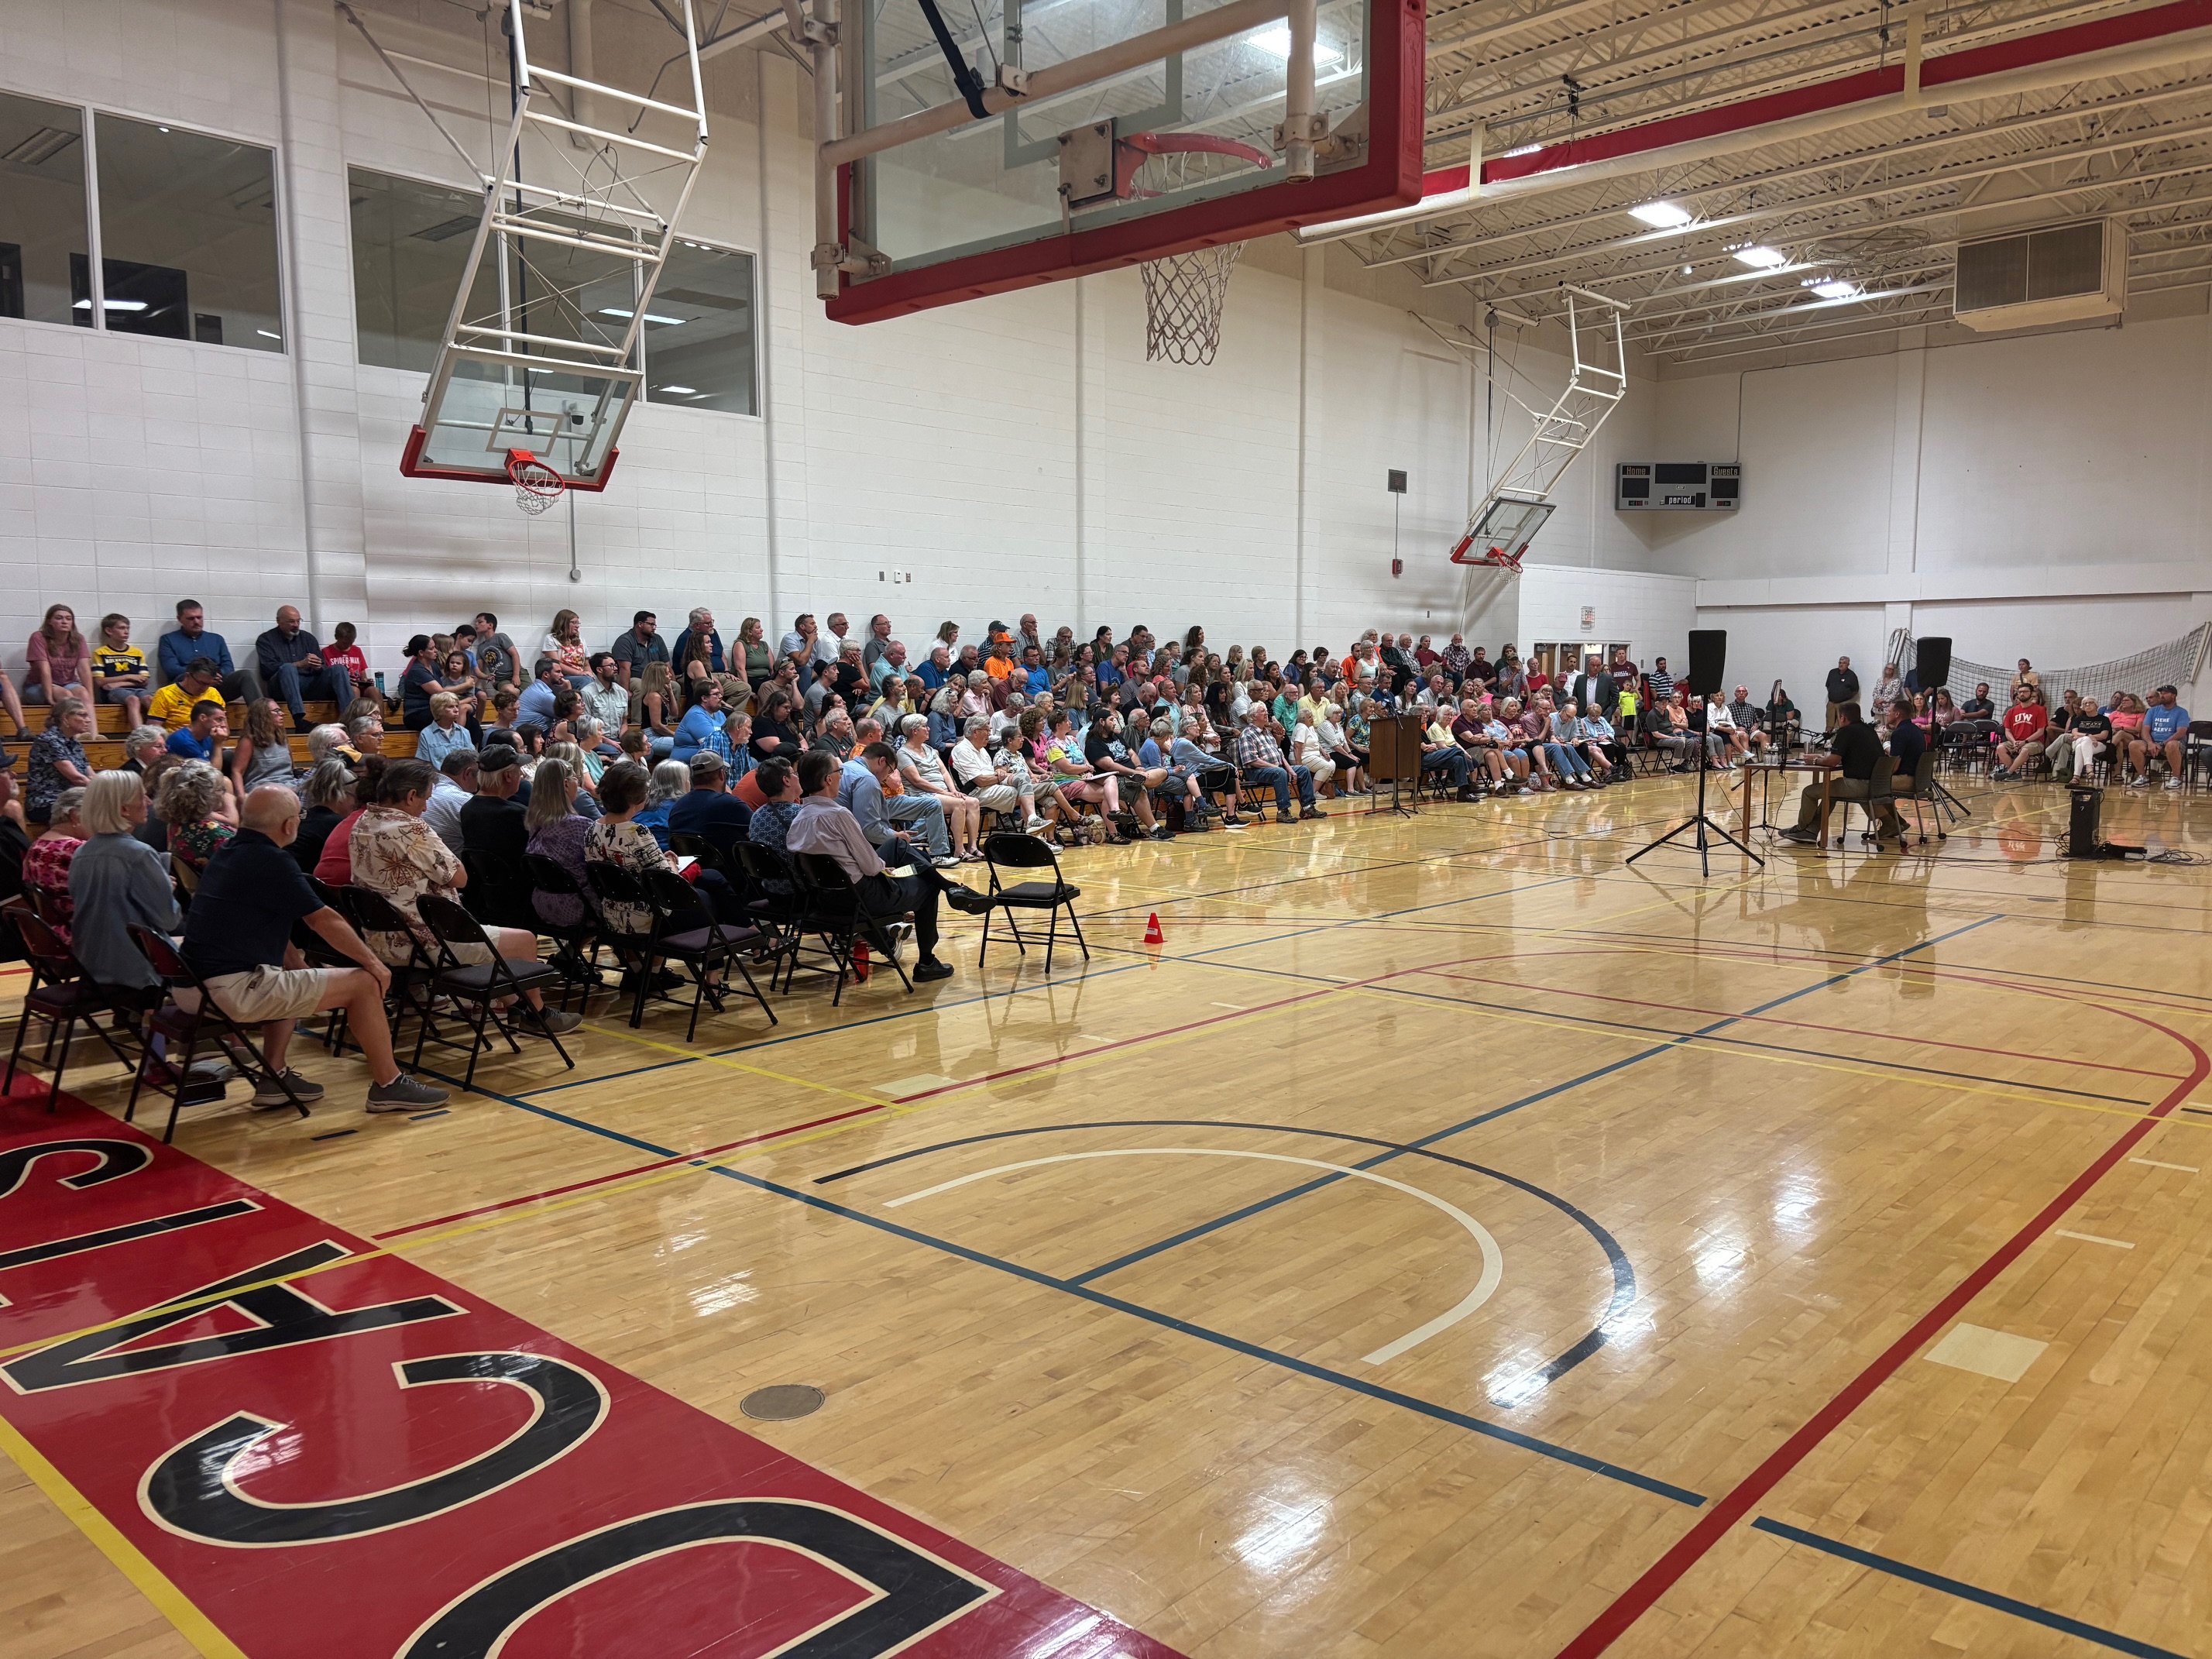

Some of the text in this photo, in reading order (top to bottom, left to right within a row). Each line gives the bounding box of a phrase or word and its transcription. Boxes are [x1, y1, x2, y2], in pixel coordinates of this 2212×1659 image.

[1626, 466, 1646, 476] Home
[1713, 466, 1738, 476] Guests
[1668, 496, 1692, 505] period
[330, 656, 360, 665] SPIDER-MAN
[114, 661, 131, 672] M
[2014, 713, 2033, 723] UW
